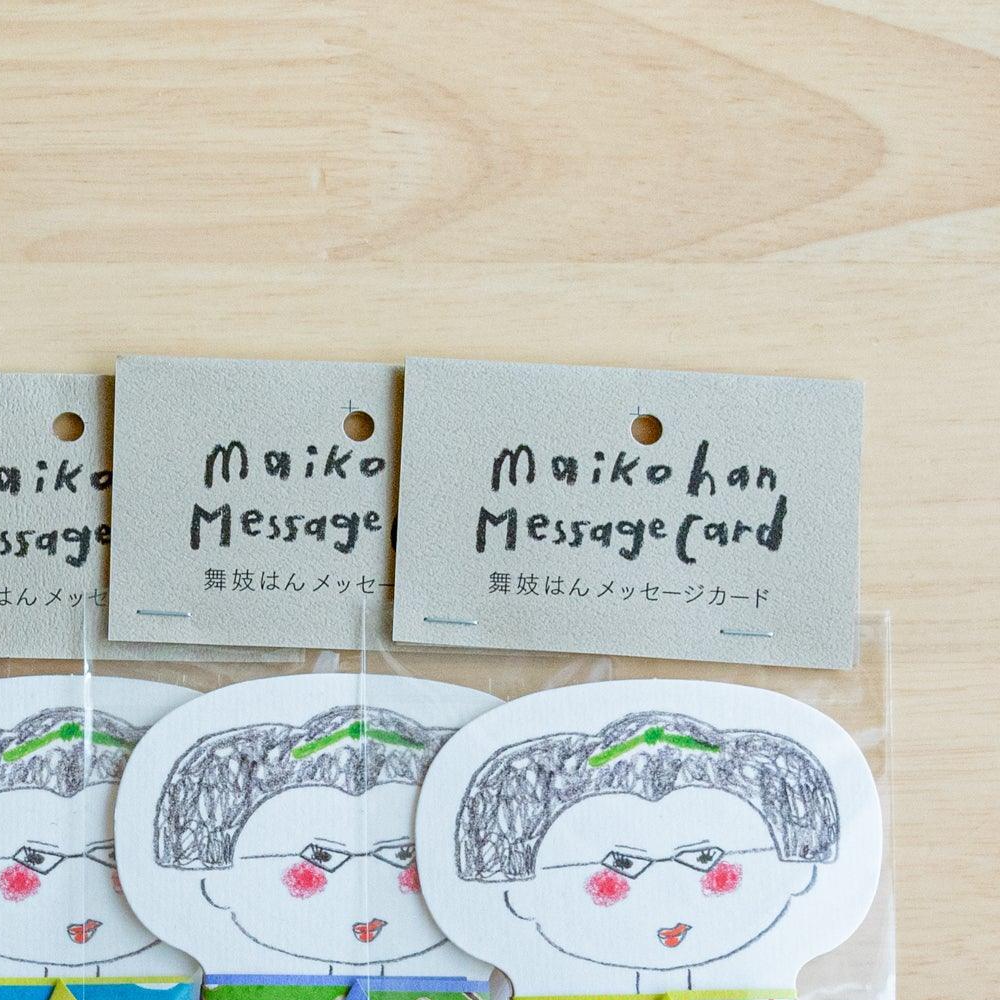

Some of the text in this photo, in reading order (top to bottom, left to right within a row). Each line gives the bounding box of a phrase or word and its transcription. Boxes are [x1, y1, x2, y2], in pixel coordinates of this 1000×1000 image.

[190, 503, 382, 554] Message
[476, 495, 787, 564] Message Card
